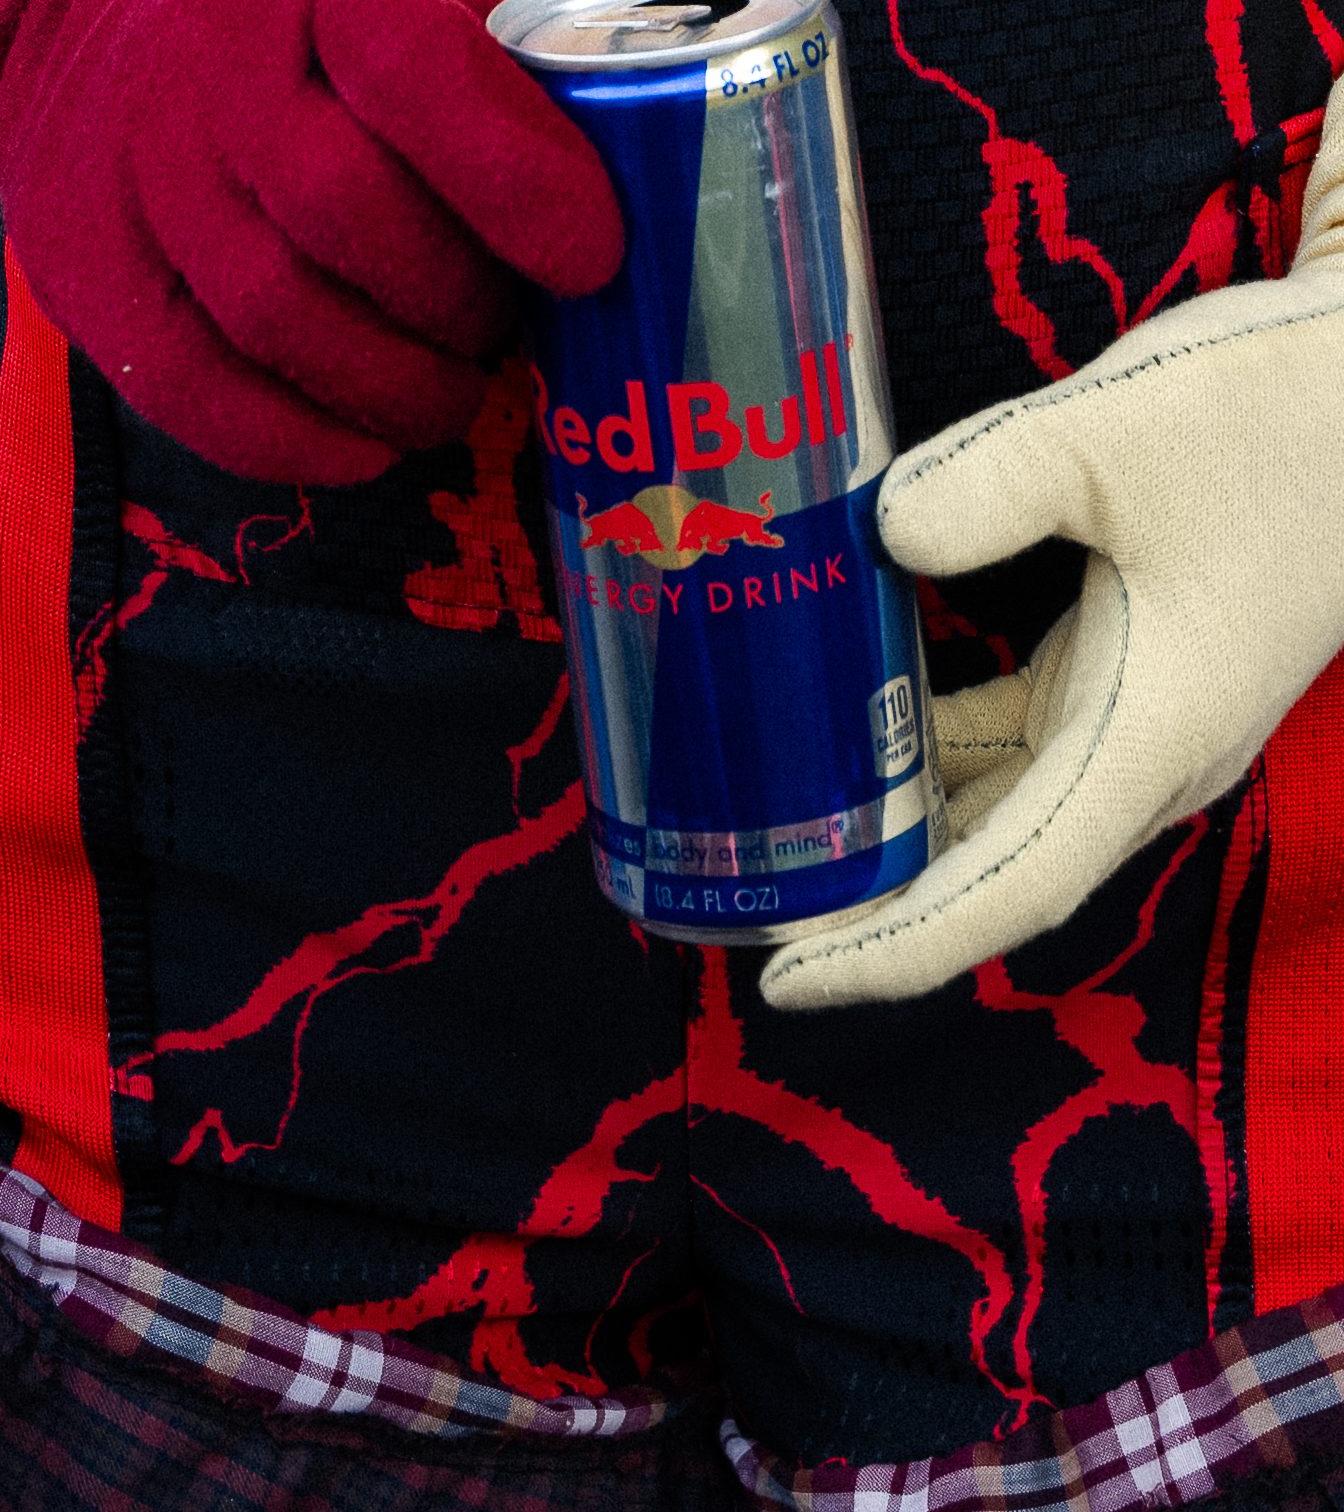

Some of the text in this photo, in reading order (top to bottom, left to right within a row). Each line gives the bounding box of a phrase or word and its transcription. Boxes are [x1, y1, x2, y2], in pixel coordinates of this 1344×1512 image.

[720, 30, 830, 98] 8.4 FL OZ
[562, 552, 847, 615] NERGY DRINK
[878, 684, 909, 731] 110
[652, 829, 706, 868] body
[654, 883, 696, 910] (8.4
[703, 890, 727, 913] FL
[733, 884, 779, 912] OZ)
